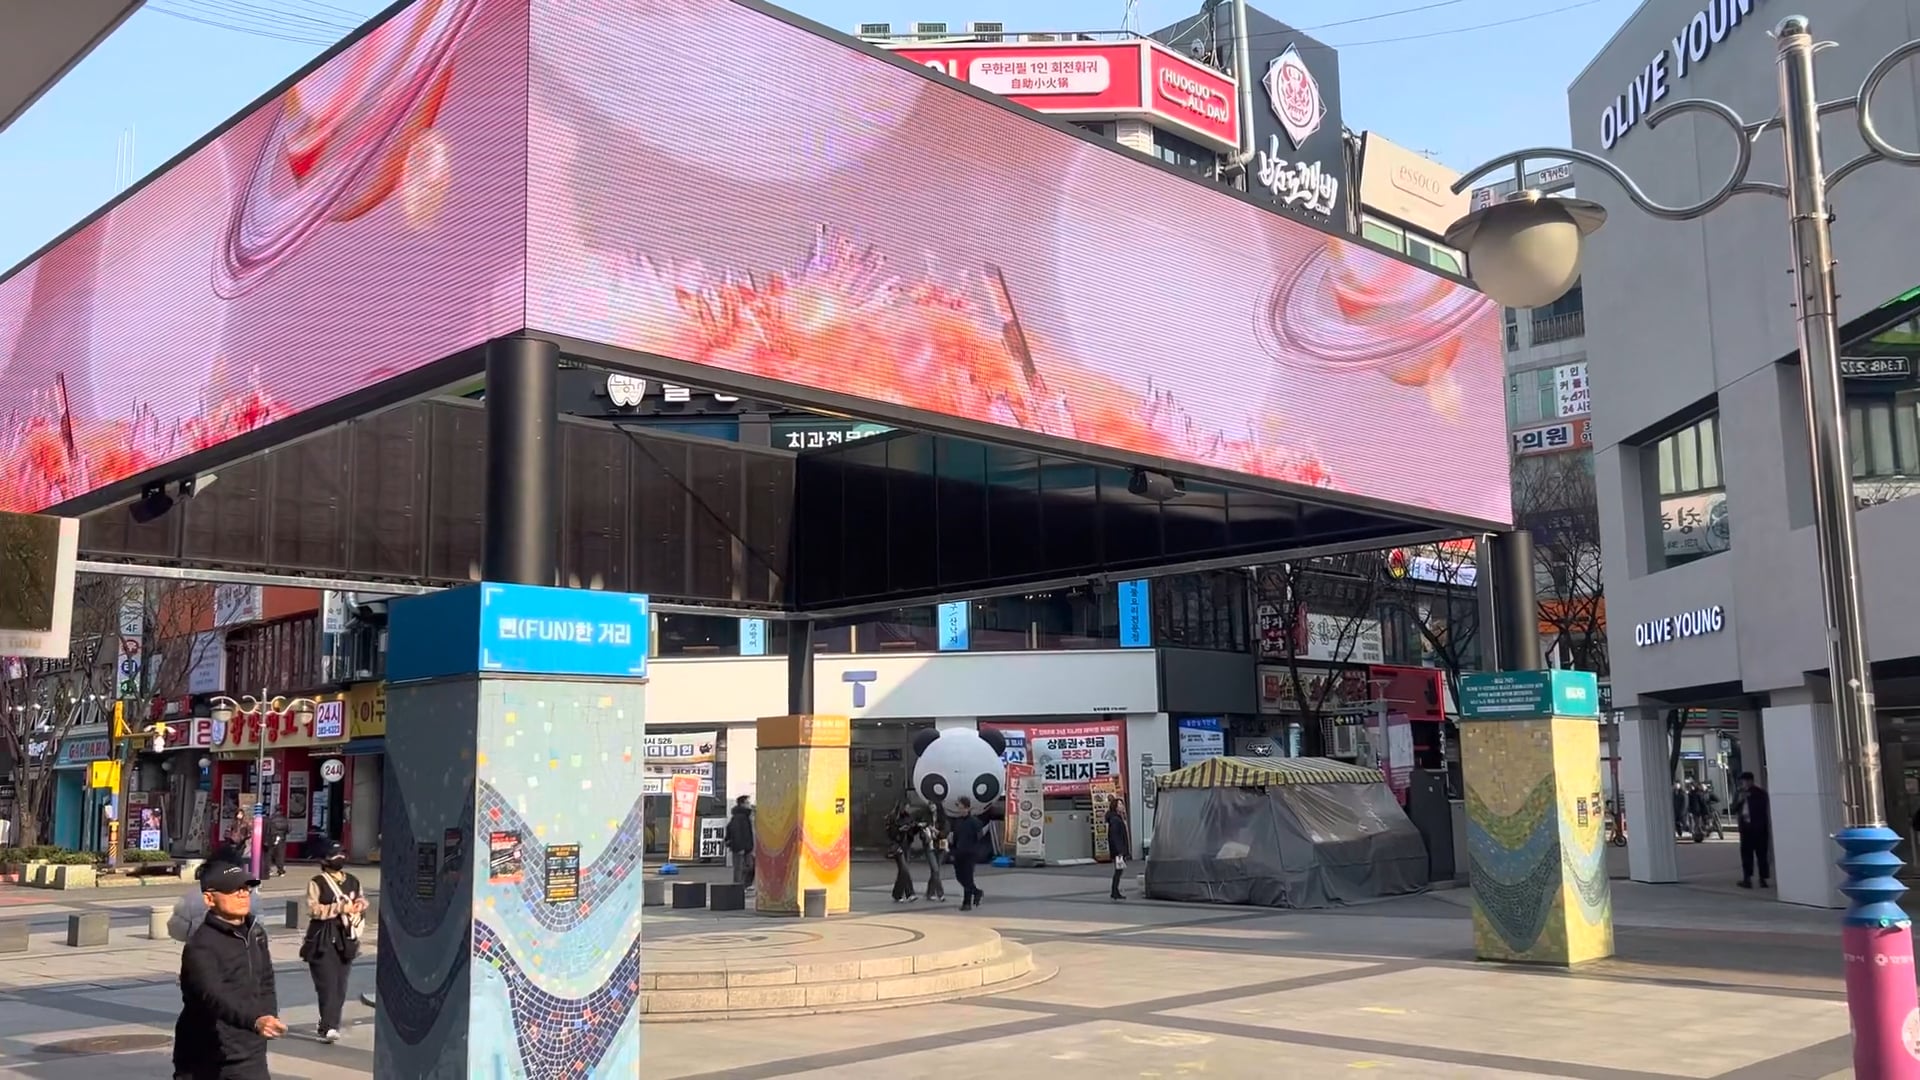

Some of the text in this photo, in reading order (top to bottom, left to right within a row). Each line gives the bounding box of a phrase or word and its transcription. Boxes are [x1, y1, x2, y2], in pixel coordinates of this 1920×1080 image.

[981, 62, 1027, 75] 무한리필
[1031, 62, 1048, 75] 1인
[1011, 78, 1069, 89] 自助小火锅
[1165, 68, 1210, 98] HUOGUO
[1187, 95, 1227, 121] ALL DAY
[1601, 50, 1667, 149] OLIVE
[598, 623, 632, 645] 거리
[1635, 604, 1723, 647] OLIVE YOUNG
[318, 702, 341, 724] 24시
[1047, 736, 1105, 750] 상품권+현금
[1062, 749, 1093, 760] 무조건
[325, 765, 343, 776] 24시
